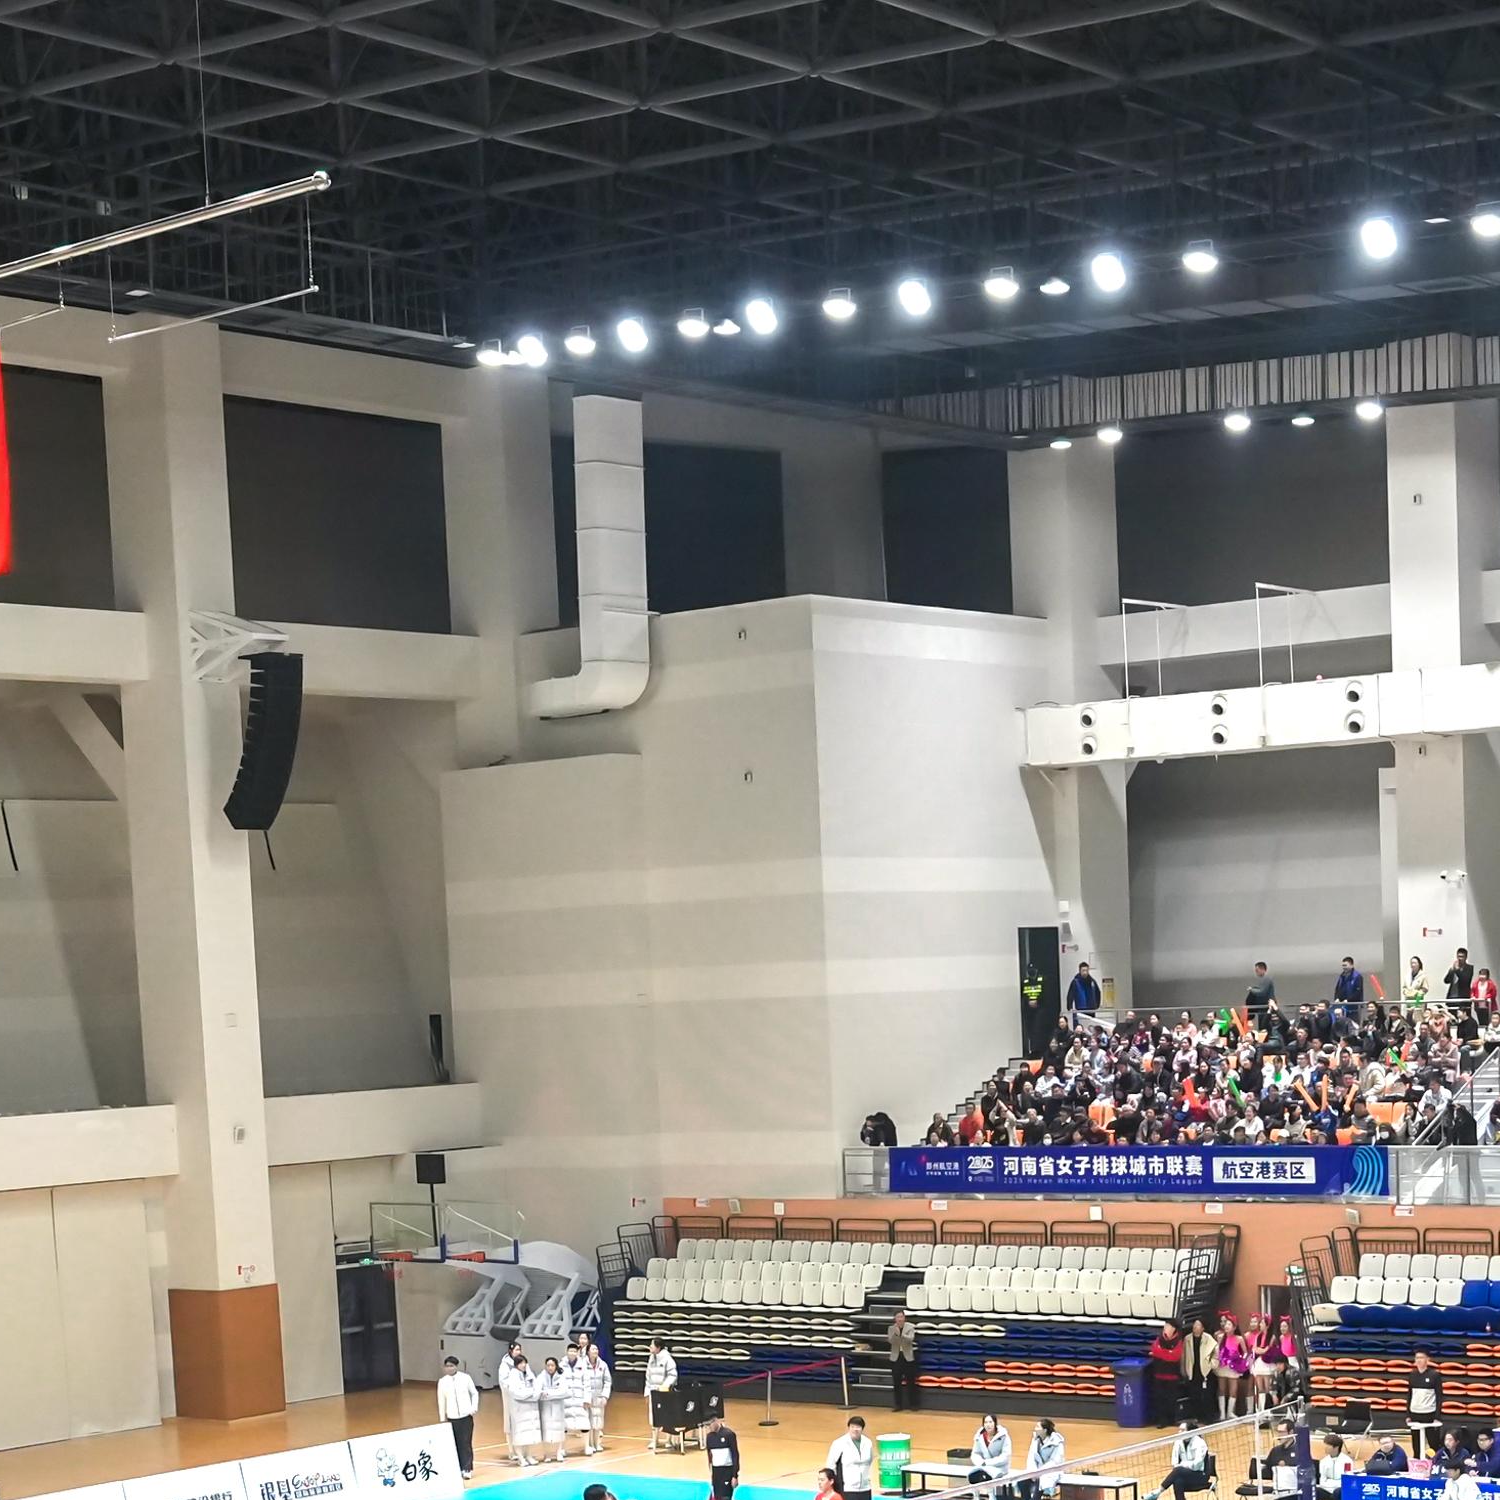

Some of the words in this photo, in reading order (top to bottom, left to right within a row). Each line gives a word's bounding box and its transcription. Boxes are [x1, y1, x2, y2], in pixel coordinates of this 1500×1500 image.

[1003, 1155, 1203, 1177] 河南省女子排球城市联赛
[1222, 1161, 1306, 1179] 航空港赛区
[402, 1450, 438, 1482] 白象
